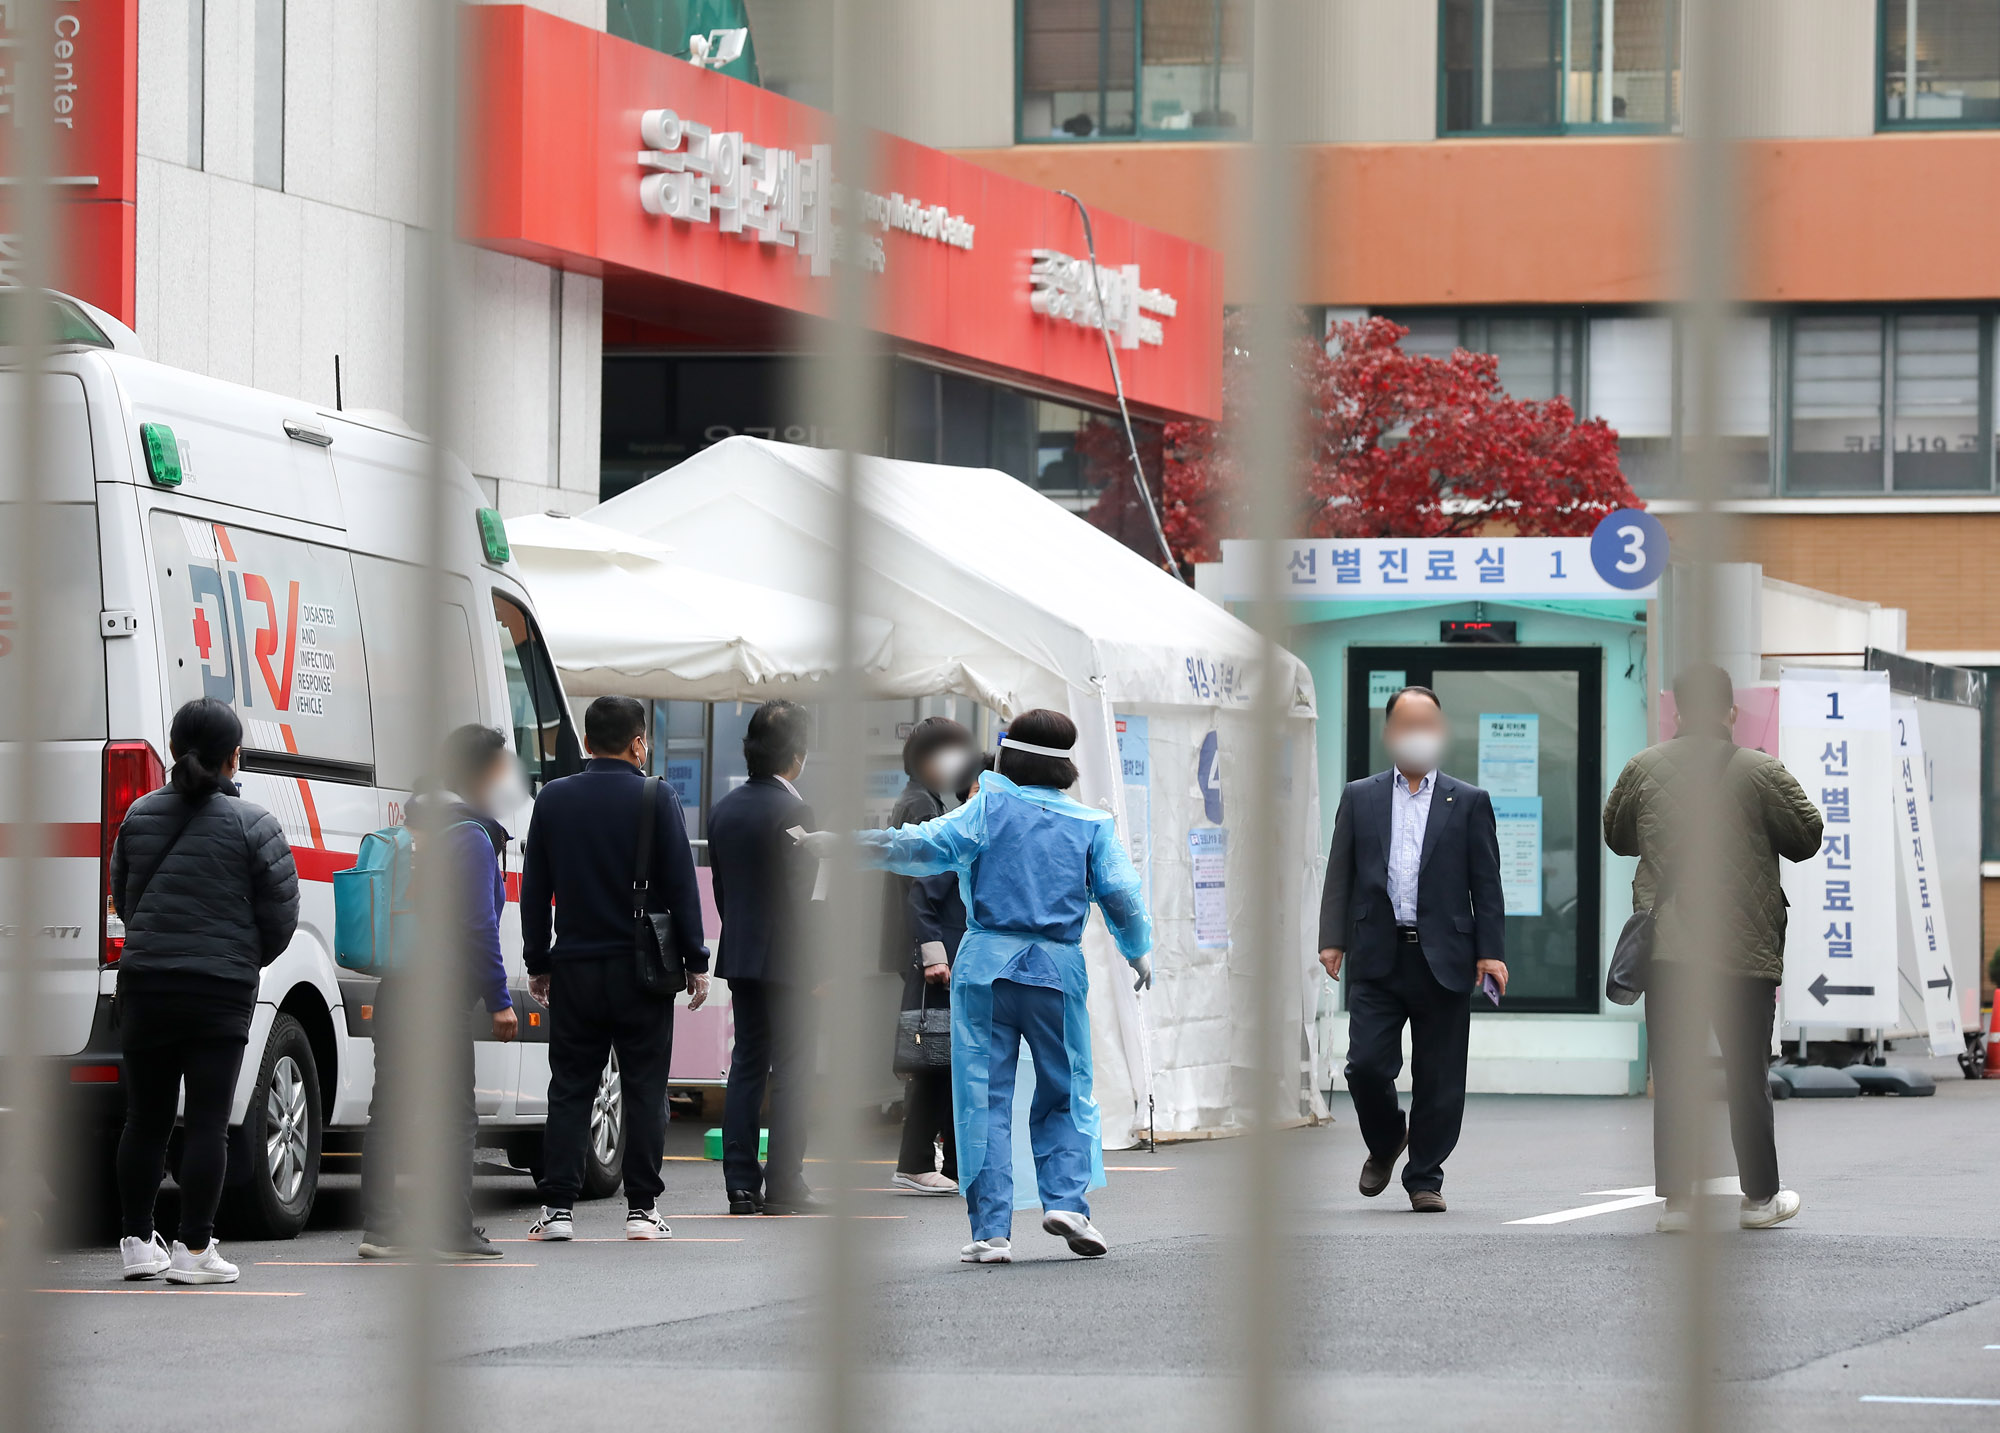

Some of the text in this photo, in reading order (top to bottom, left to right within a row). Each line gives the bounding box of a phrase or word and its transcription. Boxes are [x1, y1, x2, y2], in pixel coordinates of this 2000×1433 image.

[54, 14, 80, 129] Center
[638, 108, 832, 277] 응급의료센터
[890, 191, 937, 239] Medical
[936, 206, 975, 250] Center
[1287, 548, 1566, 585] 선별진료실 1
[1614, 525, 1647, 574] 3
[301, 627, 316, 645] AND
[303, 605, 336, 625] DISASTER
[188, 564, 300, 711] DIRV
[299, 650, 335, 671] INFECTION
[297, 672, 332, 693] RESPONSE
[294, 695, 323, 715] VEHICLE
[1824, 692, 1845, 720] 1
[1897, 718, 1908, 747] 2
[1207, 749, 1221, 803] 4
[1820, 740, 1855, 959] 선별진료실
[1902, 756, 1938, 952] 선별진료실
